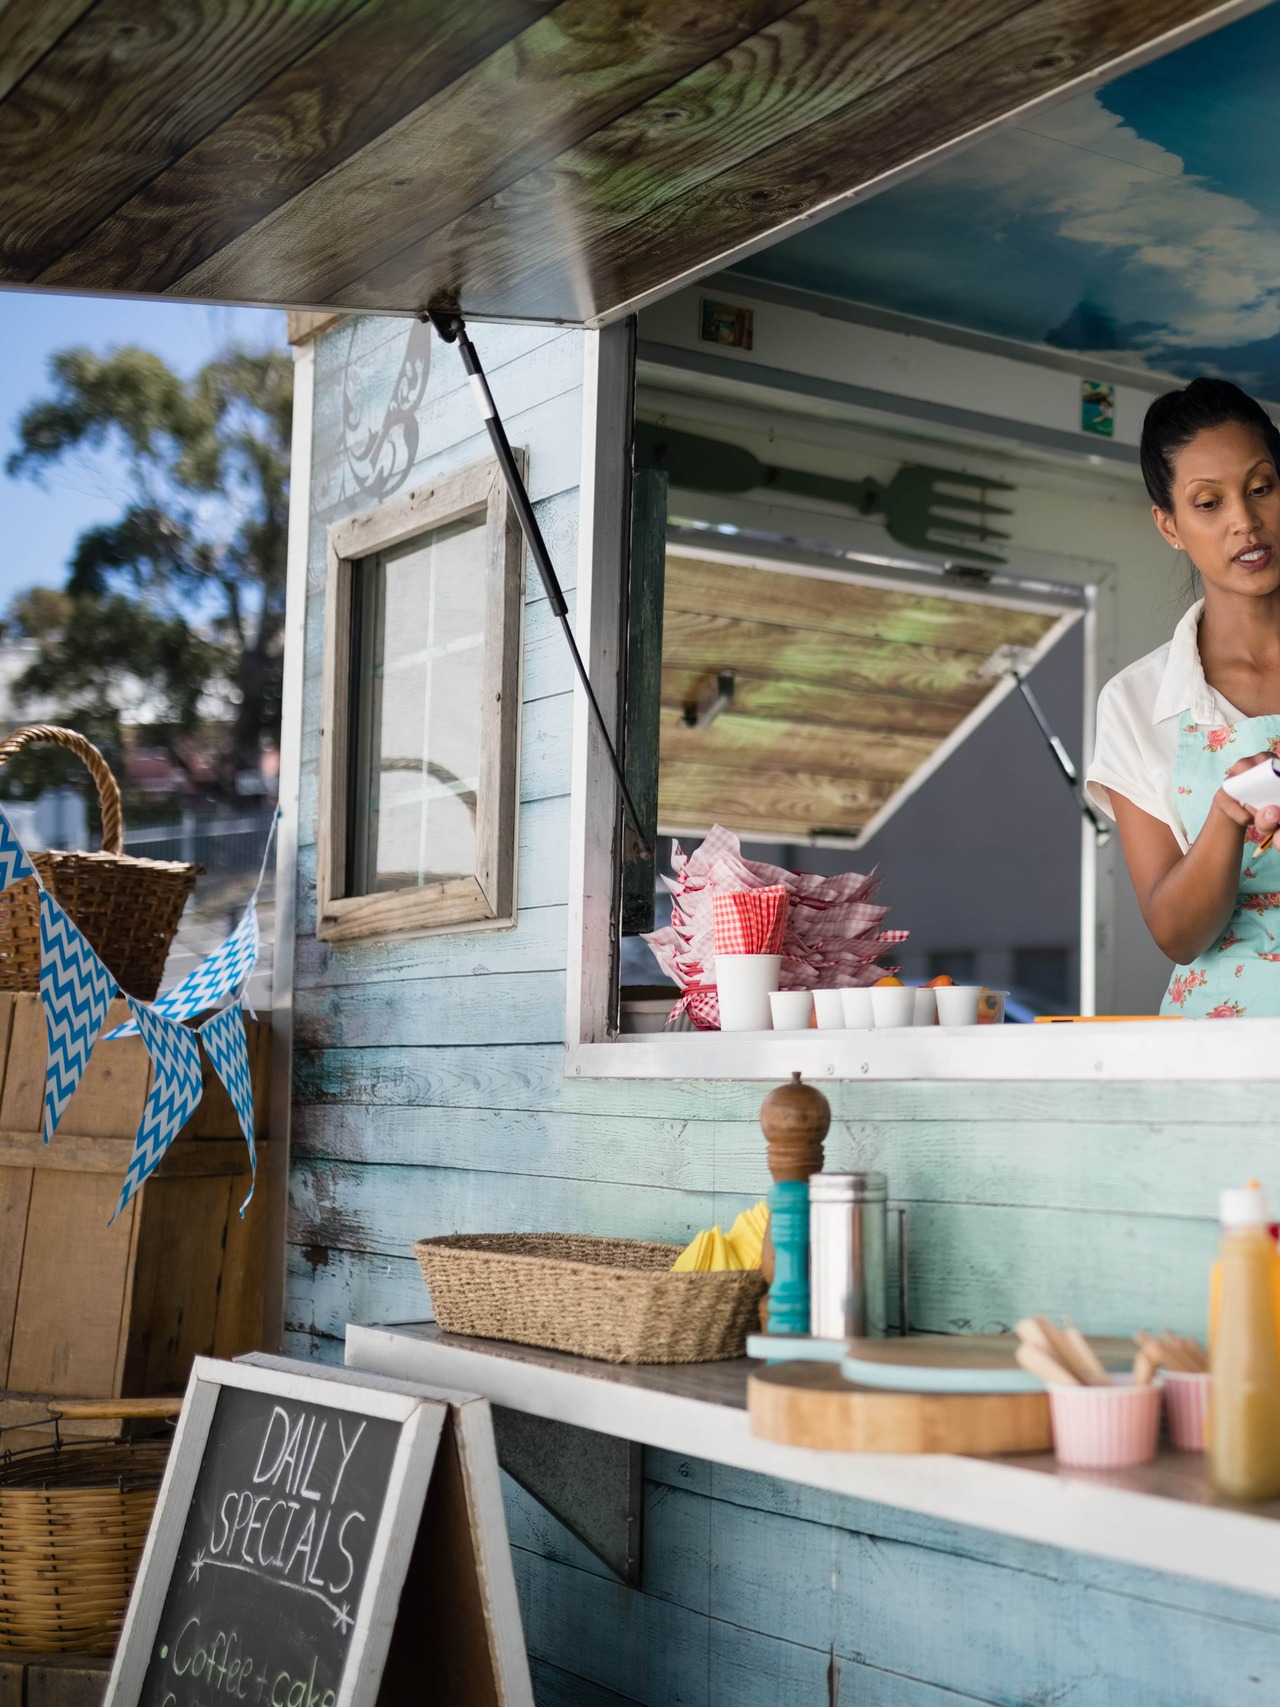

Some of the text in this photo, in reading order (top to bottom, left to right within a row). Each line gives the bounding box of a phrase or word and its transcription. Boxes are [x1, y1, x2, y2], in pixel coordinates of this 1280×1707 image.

[253, 1406, 367, 1504] DAILY
[210, 1491, 366, 1594] SPECIALS
[173, 1617, 253, 1698] Coffee
